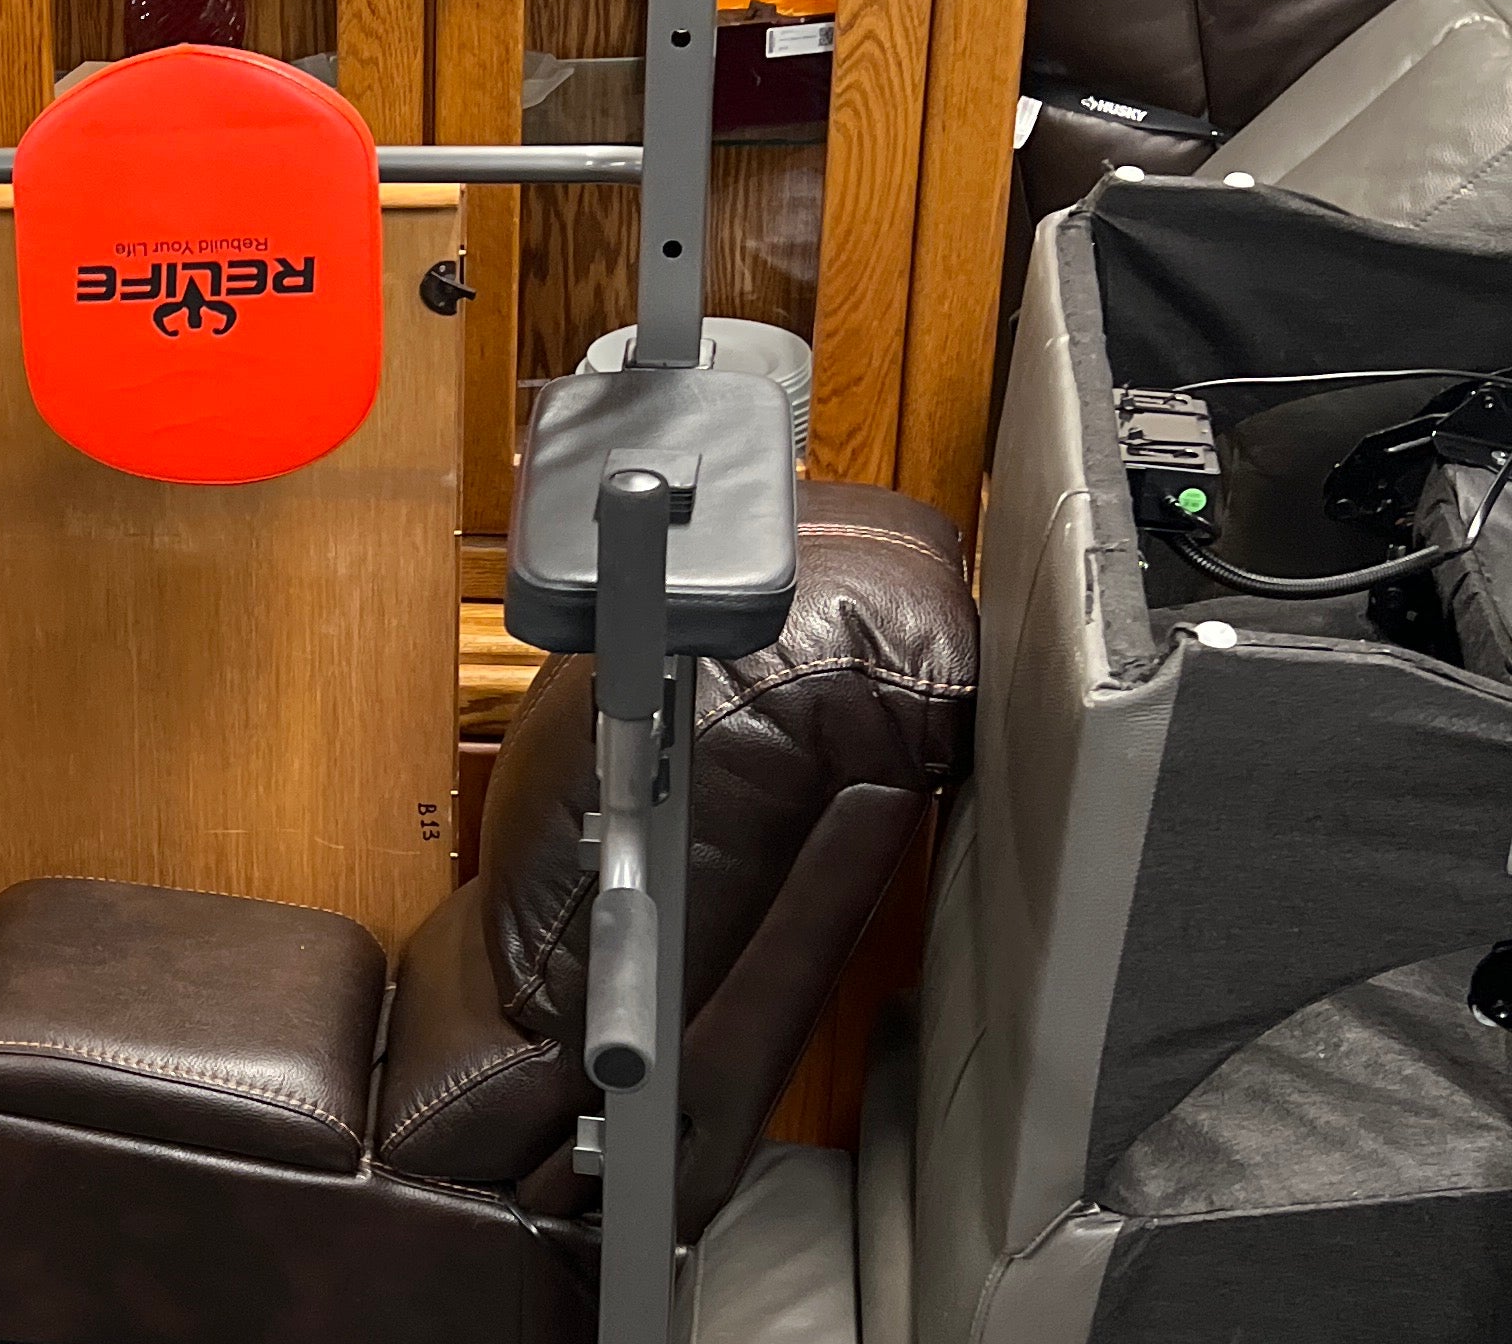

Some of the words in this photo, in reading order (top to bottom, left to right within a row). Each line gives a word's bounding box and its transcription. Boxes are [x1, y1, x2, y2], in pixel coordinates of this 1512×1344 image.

[1097, 99, 1148, 122] HUSKY
[115, 241, 148, 257] Life
[153, 240, 194, 255] Your
[199, 237, 268, 254] Rebuild
[76, 256, 316, 302] RELIFE
